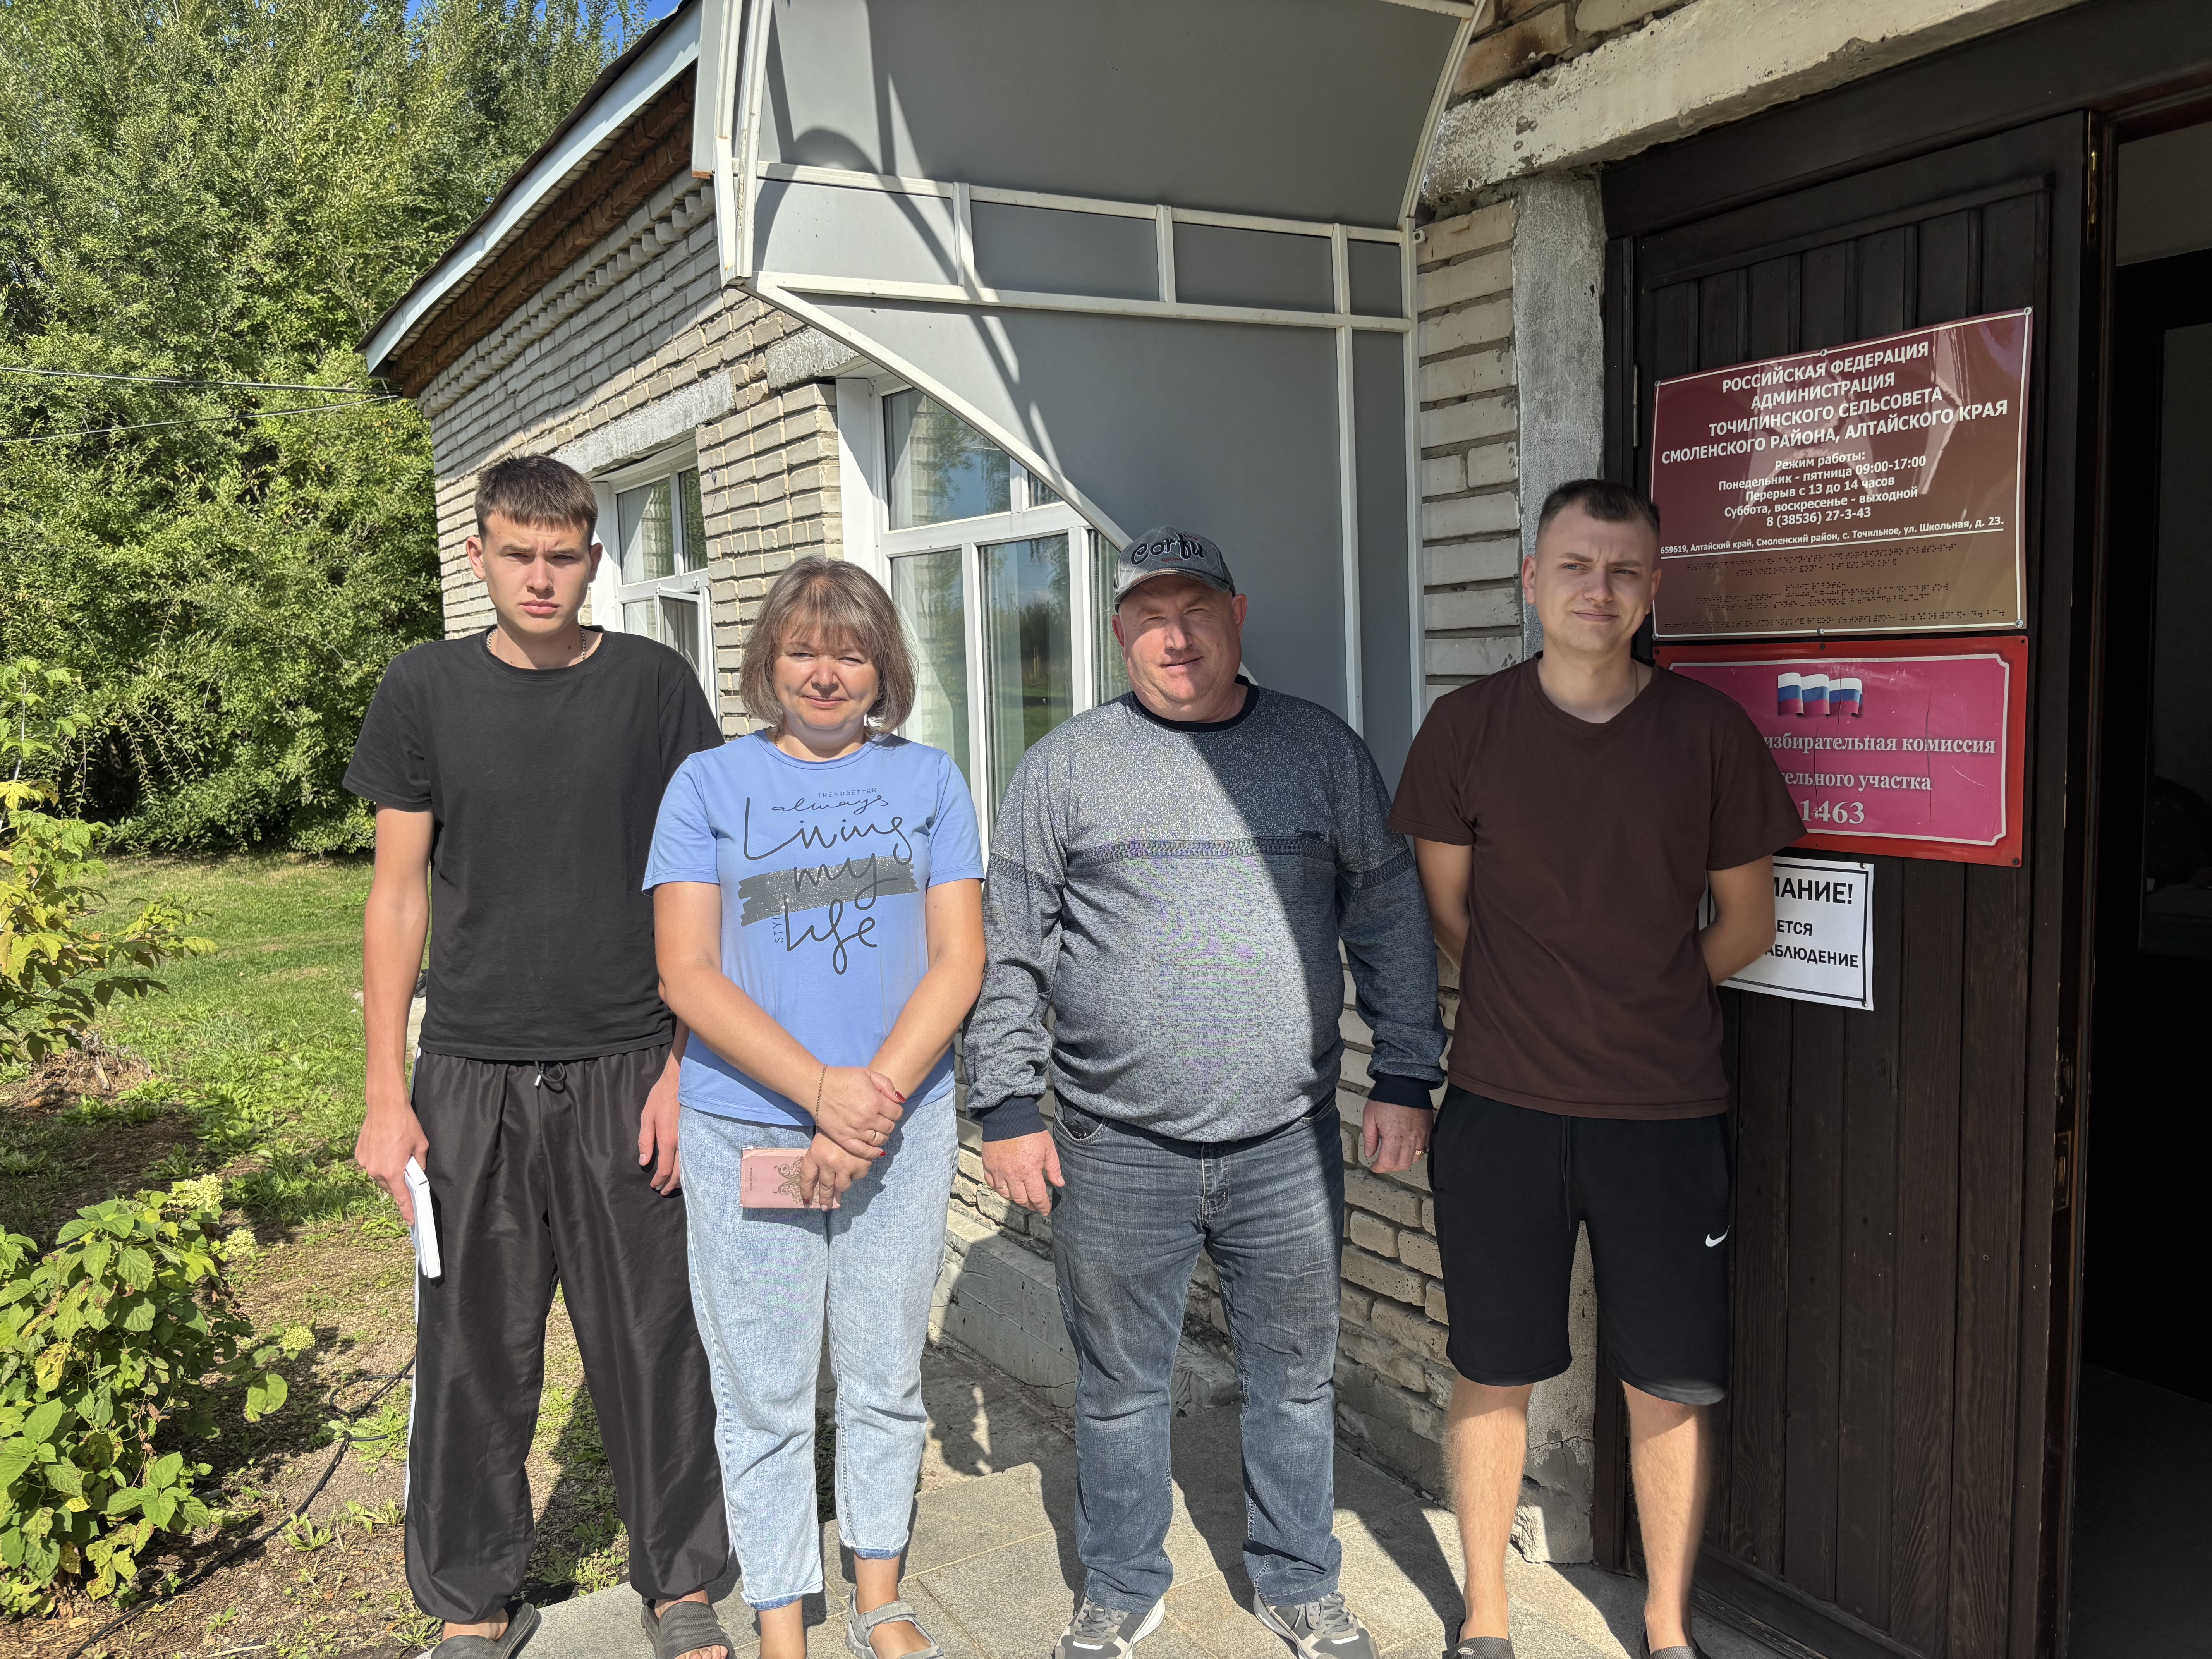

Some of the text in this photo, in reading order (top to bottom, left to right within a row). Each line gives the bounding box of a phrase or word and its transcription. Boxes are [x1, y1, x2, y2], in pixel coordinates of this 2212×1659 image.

[1723, 341, 1929, 393] РОССИЙСКАЯ ФЕДЕРАЦИЯ
[1750, 372, 1894, 410] АДМИНИСТРАЦИЯ
[1709, 386, 1943, 437] ТОЧИЛИНСКОГО СЕЛЬСОВЕТА
[1662, 400, 2008, 464] СМОЛЕНСКОГО РАЙОНА, АЛТАЙСКОГО КРАЯ
[1719, 474, 1792, 492] Понедельник
[1803, 467, 1852, 482] пятница
[1855, 455, 1926, 476] 09:00-17:00
[1775, 451, 1865, 471] Режим работы:
[1724, 503, 1772, 519] Суббота,
[1774, 496, 1848, 513] воскресенье
[1859, 486, 1918, 504] выходной
[1746, 476, 1895, 504] Перерыв с 13 до 14 часов
[1766, 507, 1871, 528] 8 (38536) 27-3-43
[1660, 545, 1688, 554] 659619,
[1690, 540, 1731, 552] Алтайский
[1733, 539, 1754, 550] край,
[1756, 534, 1808, 546] Смоленский
[1810, 532, 1840, 544] район,
[1852, 527, 1901, 538] Точильное,
[1903, 526, 1917, 536] ул.
[1919, 520, 1972, 532] Школьная,
[1975, 519, 1985, 528] д.
[1988, 516, 2004, 526] 23.
[1763, 732, 1996, 754] избирательная комиссия
[817, 787, 877, 798] TRENDSETTER
[1781, 772, 1931, 791] ельного участка
[771, 795, 889, 815] always
[1800, 799, 1865, 824] 1463
[793, 853, 898, 910] my
[770, 906, 784, 943] STYLE
[783, 895, 878, 975] Life
[1776, 919, 1813, 936] ЕТСЯ
[1764, 944, 1858, 968] АБЛЮДЕНИЕ
